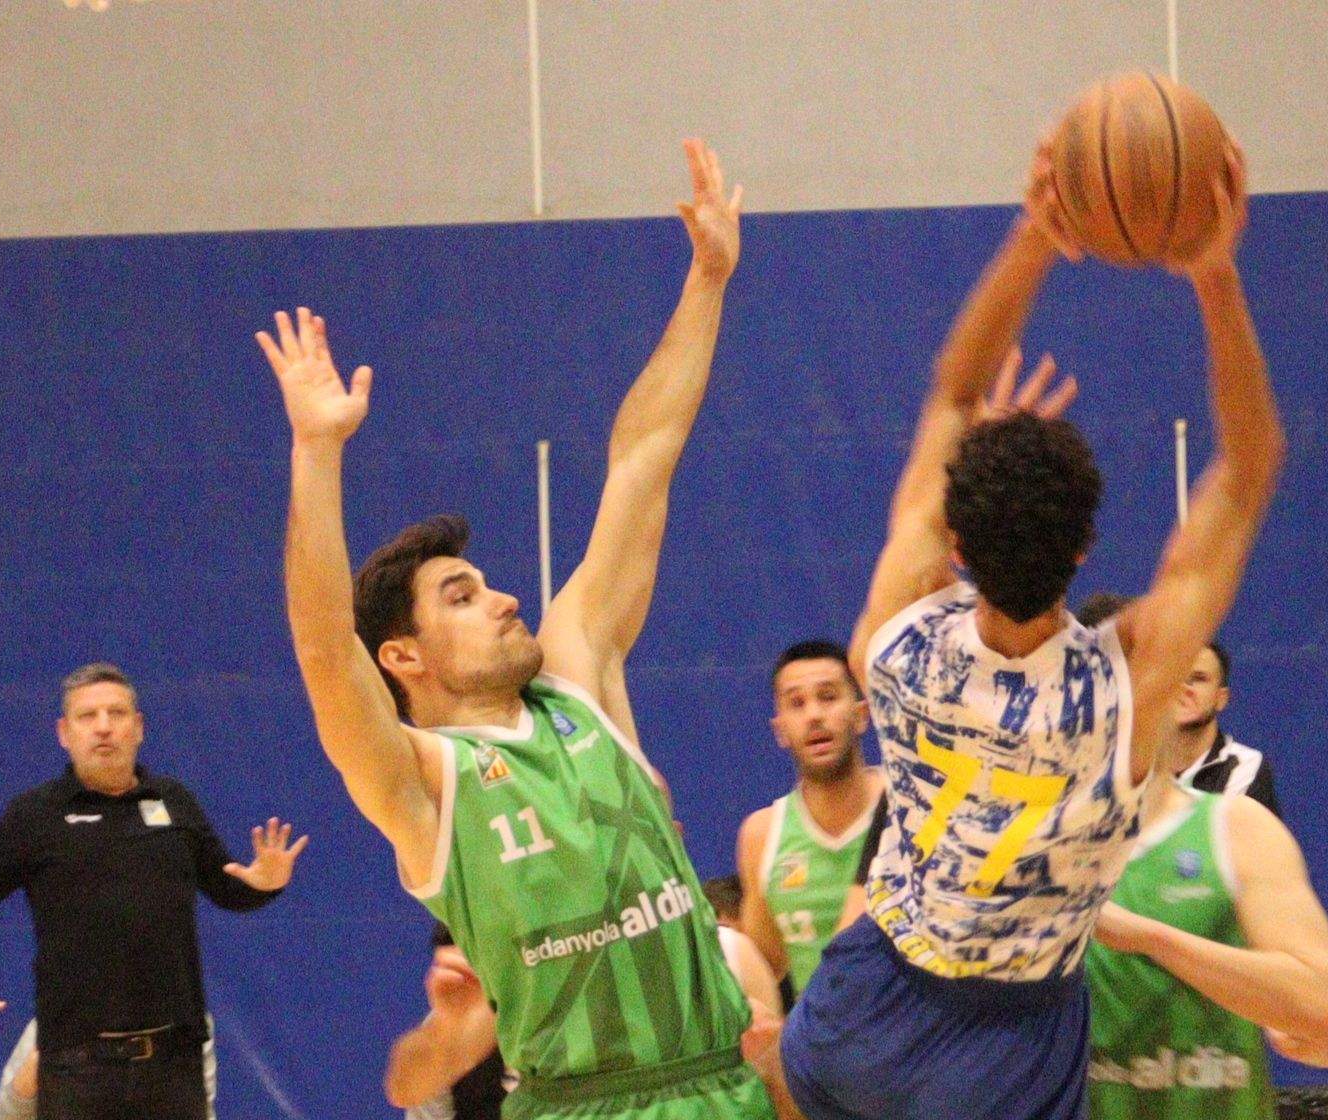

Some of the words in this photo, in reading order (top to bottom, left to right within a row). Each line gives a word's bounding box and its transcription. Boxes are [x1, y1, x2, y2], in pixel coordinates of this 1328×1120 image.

[489, 806, 554, 863] 11
[912, 720, 1068, 898] 77
[620, 891, 659, 938] al
